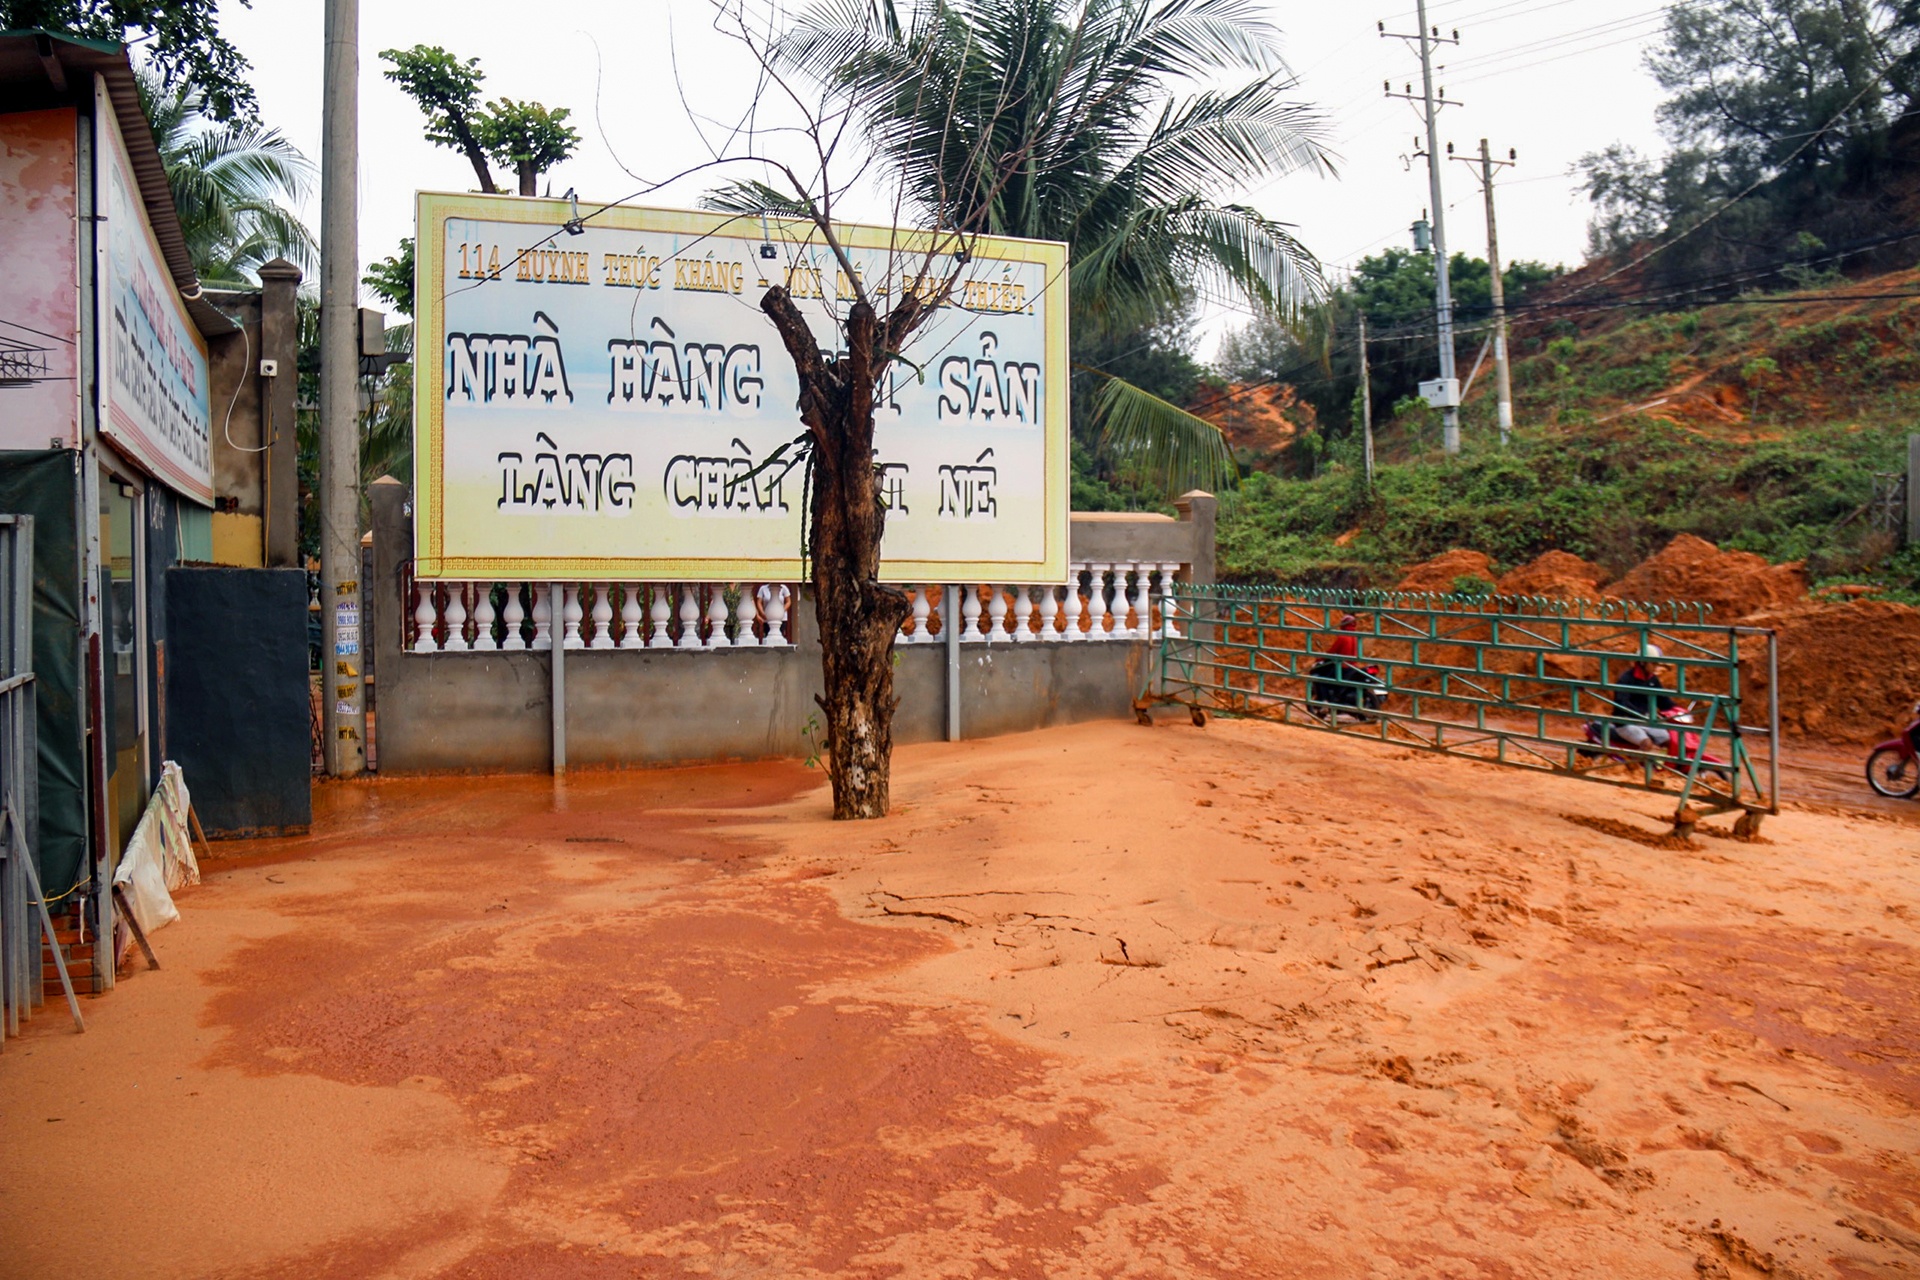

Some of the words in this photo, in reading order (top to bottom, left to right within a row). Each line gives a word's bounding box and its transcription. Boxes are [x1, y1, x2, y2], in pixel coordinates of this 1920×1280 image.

[458, 243, 501, 280] 114
[515, 240, 590, 284] HUỲNH
[603, 245, 661, 288] THÚC
[673, 250, 744, 294] KHÁNG
[447, 311, 573, 408] NHÀ
[607, 317, 764, 416] HÀNG
[938, 331, 1040, 425] SẢN
[498, 432, 635, 516] LÀNG
[664, 438, 789, 518] CHÀI
[938, 448, 997, 522] NÉ
